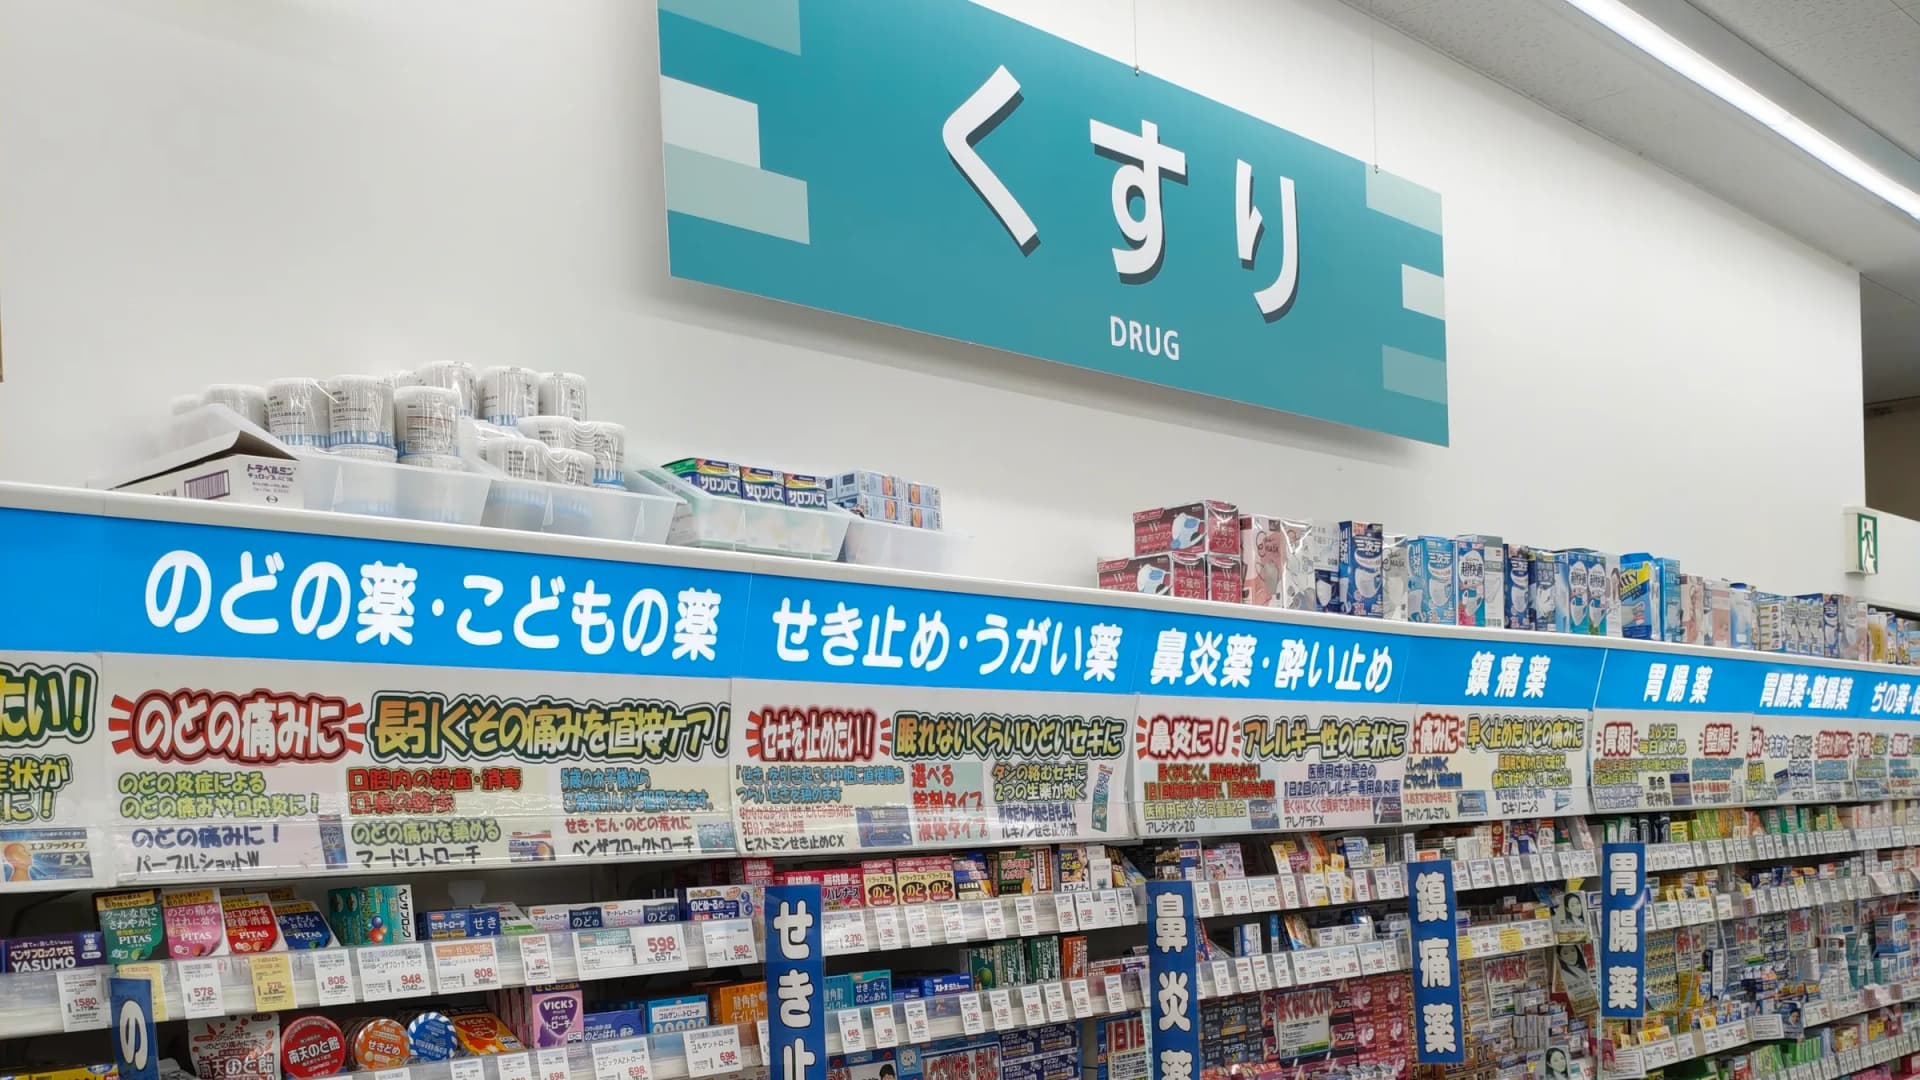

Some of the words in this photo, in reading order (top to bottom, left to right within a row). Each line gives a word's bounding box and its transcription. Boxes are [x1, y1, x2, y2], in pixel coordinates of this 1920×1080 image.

[942, 64, 1299, 317] くすり
[1110, 315, 1180, 361] DRUG
[145, 550, 718, 661] のどの薬・こどもの薬
[772, 596, 1124, 681] せき止め・うがい薬
[1151, 628, 1392, 693] 鼻炎薬・酔い止め
[1465, 650, 1550, 698] 鎮痛薬
[1643, 663, 1712, 704] 胃腸薬
[1760, 672, 1853, 710] 胃腸薬・整腸薬
[136, 695, 347, 757] のどの痛みに
[374, 698, 730, 759] 長引くその痛みを直接ケア!
[895, 714, 1125, 757] 眠れないくらいひどいセキに
[1148, 715, 1229, 757] 鼻炎に!
[1243, 718, 1407, 759] アレルギー性の症状に
[348, 767, 522, 792] 口腔内の殺菌・消毒
[911, 762, 954, 789] 選べる
[992, 761, 1088, 781] タンの絡むセキに
[118, 771, 267, 796] のどの炎症による
[994, 781, 1087, 803] 2つの生薬が効く
[120, 793, 319, 819] のどの痛みや口内炎に!
[352, 818, 501, 846] のどの痛みを鎮める
[565, 815, 693, 834] せき・たん・のどの荒れに
[1146, 820, 1195, 833] アレジオン20
[1284, 815, 1325, 828] アレグラFX
[132, 824, 279, 848] のどの痛みに!
[745, 835, 845, 851] ヒストミンせき止めCX
[59, 853, 88, 867] EX
[356, 845, 481, 868] マードレトローチ
[239, 930, 269, 939] PITAS
[473, 916, 497, 930] せき
[1609, 852, 1638, 1009] 胃腸薬
[119, 934, 152, 945] PITAS
[180, 932, 212, 941] PITAS
[647, 936, 676, 953] 598
[12, 956, 76, 974] YASUMO
[655, 952, 672, 962] 657
[1416, 872, 1456, 1053] 鎮痛薬
[327, 976, 346, 985] 808
[401, 974, 422, 985] 948
[474, 968, 494, 978] 808
[193, 987, 214, 997] 578
[543, 1001, 574, 1012] VICKS
[119, 1000, 148, 1070] の
[288, 1036, 341, 1065] 南天のど飴
[368, 1038, 401, 1056] せきどめ
[720, 1051, 735, 1061] 698
[629, 1066, 646, 1077] 698
